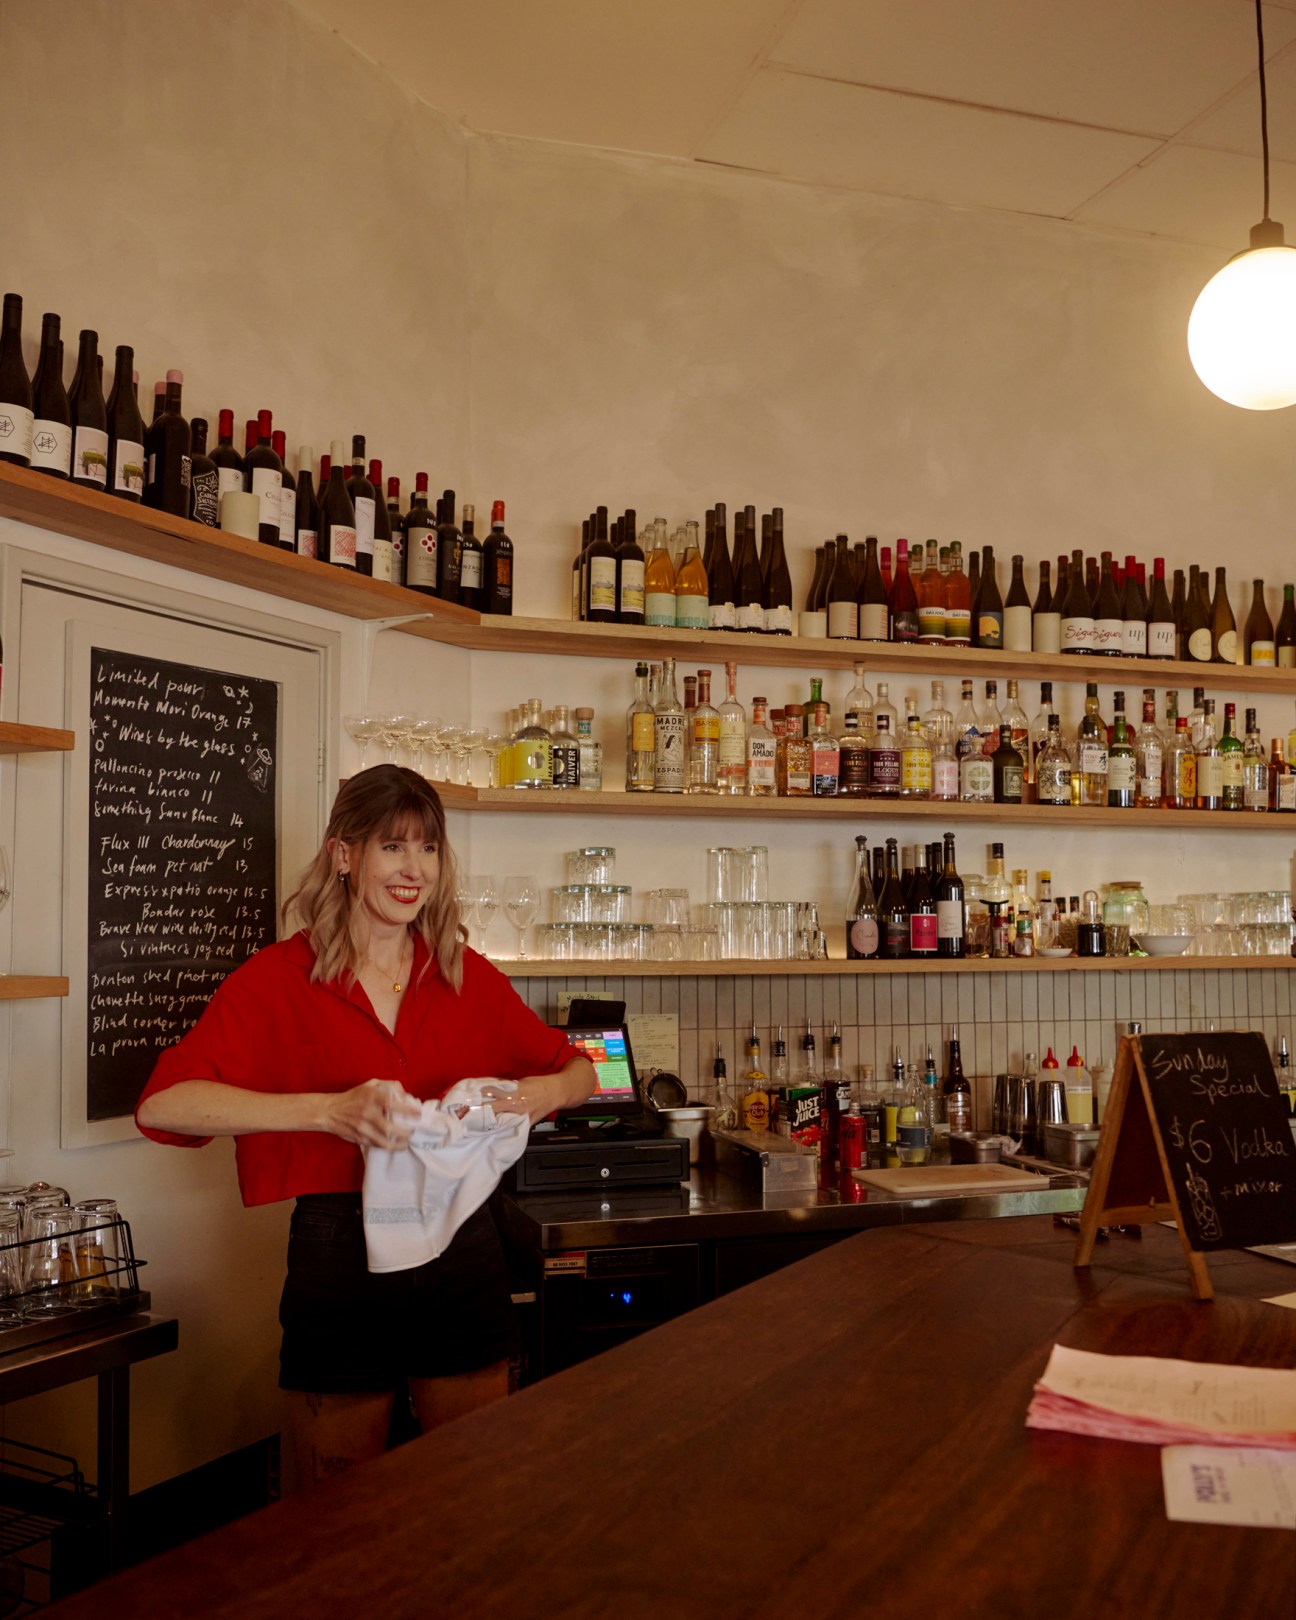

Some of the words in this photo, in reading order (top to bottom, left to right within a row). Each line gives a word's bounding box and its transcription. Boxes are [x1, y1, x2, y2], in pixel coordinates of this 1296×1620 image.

[98, 664, 159, 690] Limited
[166, 682, 203, 699] pour
[156, 702, 188, 716] Mori
[192, 704, 229, 731] Orange
[237, 716, 252, 729] 17
[119, 723, 152, 744] Wines
[158, 729, 175, 749] by
[179, 731, 198, 748] the
[200, 742, 235, 758] glass
[753, 742, 765, 750] DON
[752, 750, 774, 758] AMADO
[568, 750, 576, 783] HAIVER
[230, 813, 243, 827] 14
[101, 833, 130, 856] Flux
[162, 834, 236, 860] Chardonnay
[243, 837, 253, 850] 15
[129, 855, 156, 876] foam
[165, 860, 185, 877] pet
[190, 857, 214, 872] nat
[236, 860, 248, 872] 13
[105, 882, 157, 900] Express
[207, 889, 238, 903] orange
[142, 903, 185, 920] Bondar
[99, 921, 131, 937] Brave
[216, 943, 233, 956] red
[92, 973, 135, 989] Denton
[143, 969, 170, 983] shed
[177, 969, 209, 989] pinot
[179, 989, 217, 1012] grenac
[93, 1013, 127, 1033] Blind
[134, 1018, 176, 1031] corner
[90, 1042, 105, 1056] La
[112, 1037, 147, 1056] prova
[155, 1035, 181, 1049] nero
[1152, 1047, 1229, 1083] Sunday
[1190, 1074, 1270, 1105] Special
[796, 1096, 820, 1114] JUST
[792, 1106, 820, 1127] JUICE
[1170, 1116, 1212, 1164] $6
[1220, 1127, 1288, 1164] Vodka
